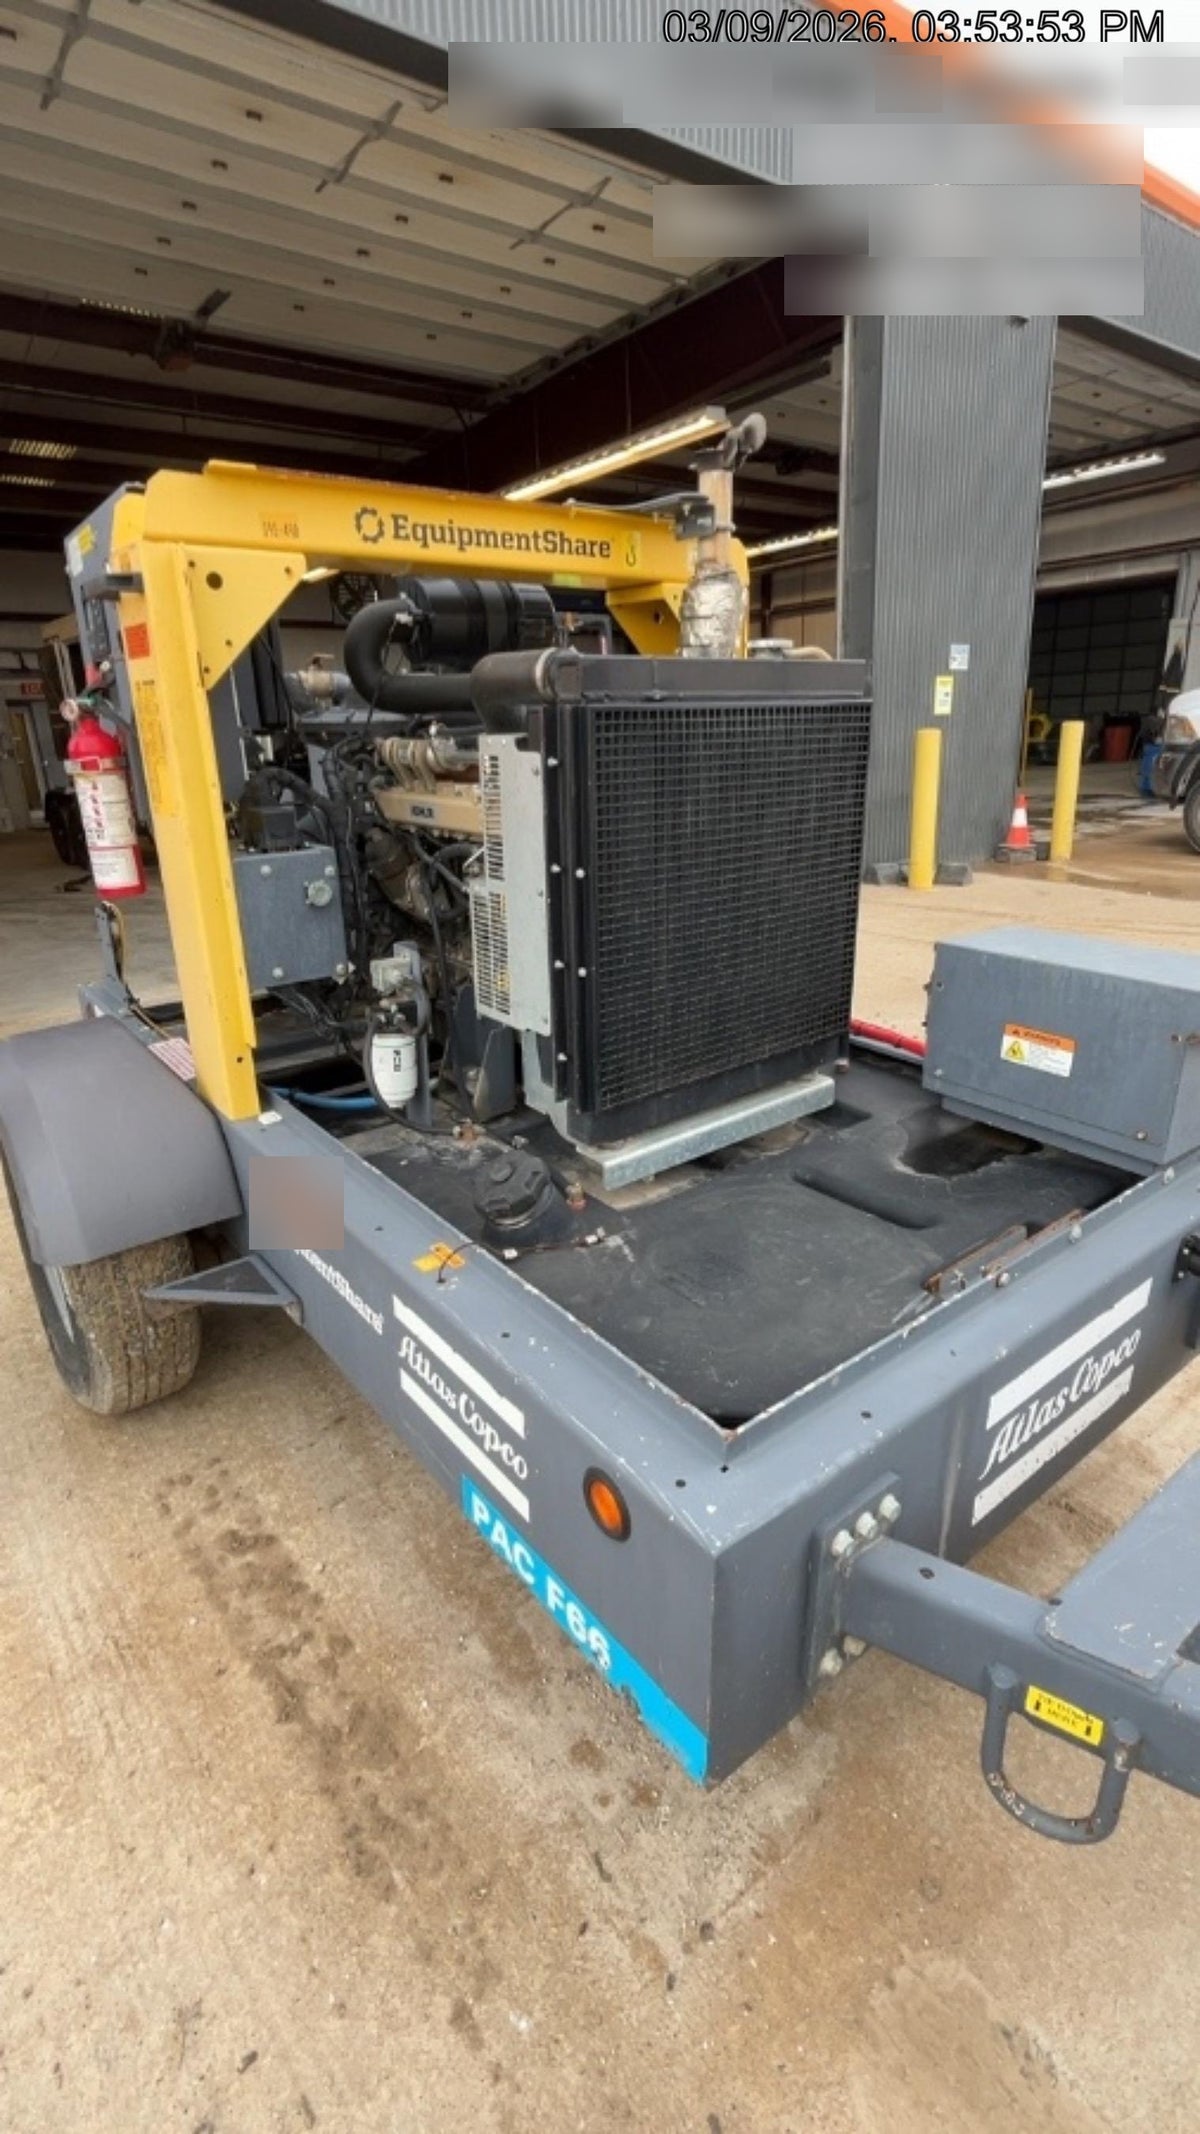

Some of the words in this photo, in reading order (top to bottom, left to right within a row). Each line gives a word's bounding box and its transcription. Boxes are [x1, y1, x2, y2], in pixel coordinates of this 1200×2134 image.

[391, 514, 611, 558] EquipmentShare
[398, 1336, 457, 1410] Atlas
[459, 1391, 528, 1480] Copco
[976, 1386, 1069, 1480] Atlas
[1069, 1328, 1142, 1402] Copco
[471, 1491, 535, 1585] PAC
